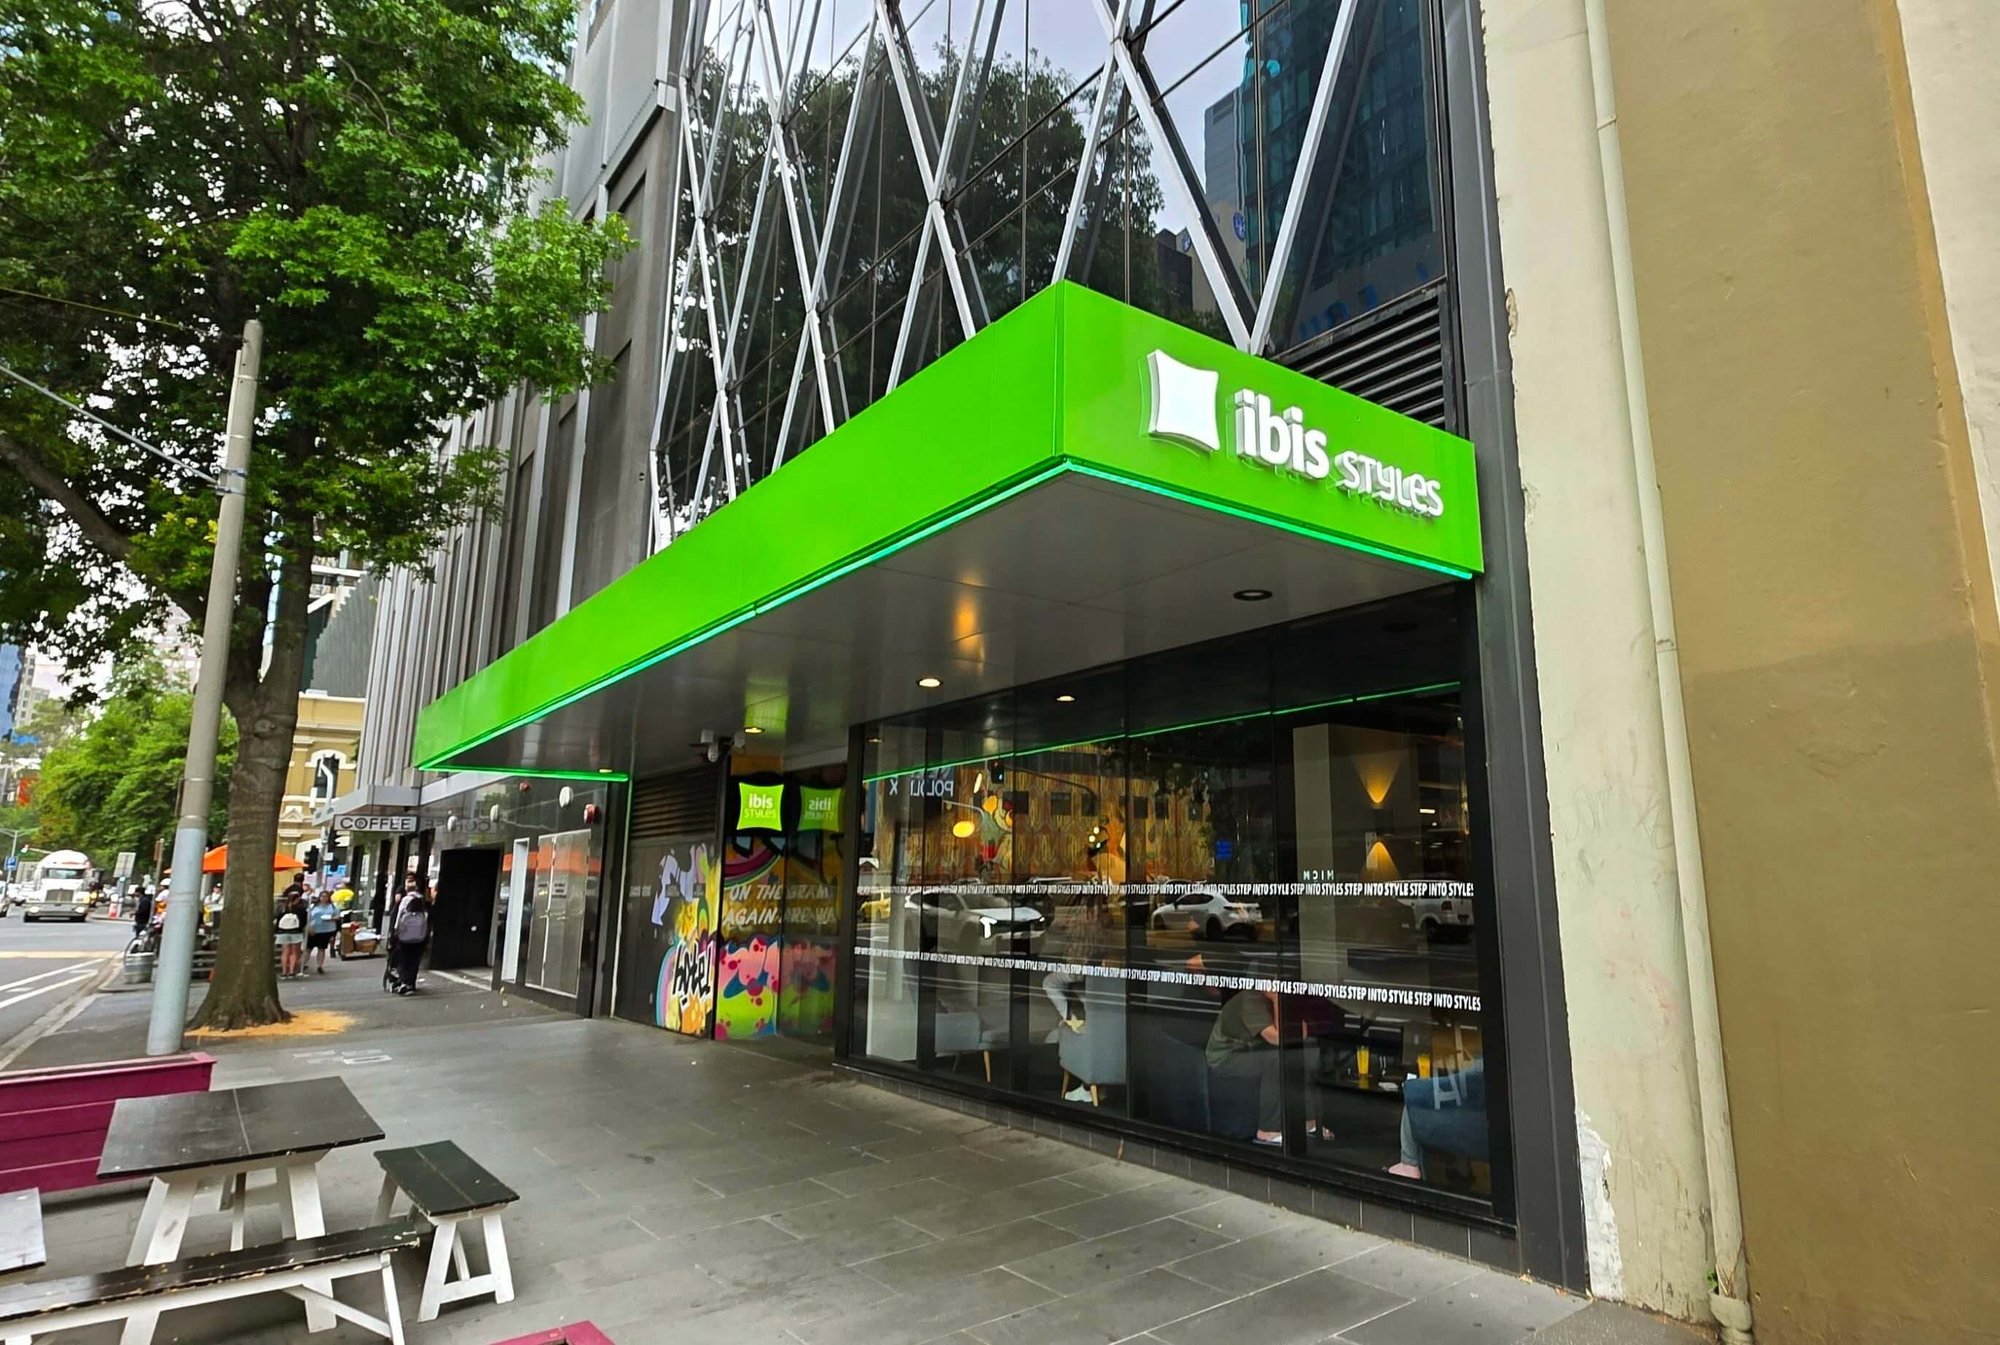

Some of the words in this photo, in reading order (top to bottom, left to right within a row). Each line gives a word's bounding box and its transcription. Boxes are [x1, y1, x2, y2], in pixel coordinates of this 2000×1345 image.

[1235, 389, 1330, 479] ibis
[748, 793, 773, 809] ibis
[340, 817, 411, 830] COFFEE
[1236, 883, 1251, 895] STEP
[1252, 883, 1268, 895] INTO
[1269, 883, 1289, 895] STYLE
[1290, 883, 1304, 895] STEP
[1306, 883, 1320, 896] INTO
[1322, 883, 1344, 896] STYLES
[1345, 883, 1362, 896] STEP
[1364, 883, 1383, 896] INTO
[1384, 883, 1408, 896] STYLE
[1410, 882, 1425, 896] STEP
[1428, 882, 1448, 896] INTO
[722, 907, 778, 926] AGAIN
[1219, 976, 1238, 988] STYLES
[1239, 978, 1254, 990] STEP
[1255, 980, 1271, 992] INTO
[1272, 980, 1291, 994] STYLE
[1293, 982, 1307, 995] STEP
[1308, 983, 1324, 997] INTO
[1324, 984, 1347, 998] STYLES
[1348, 986, 1366, 1000] STEP
[1368, 988, 1387, 1002] INTO
[1389, 990, 1413, 1005] STYLE
[1415, 991, 1432, 1006] STEP
[1434, 994, 1452, 1008] INTO
[1454, 996, 1481, 1011] STYLES
